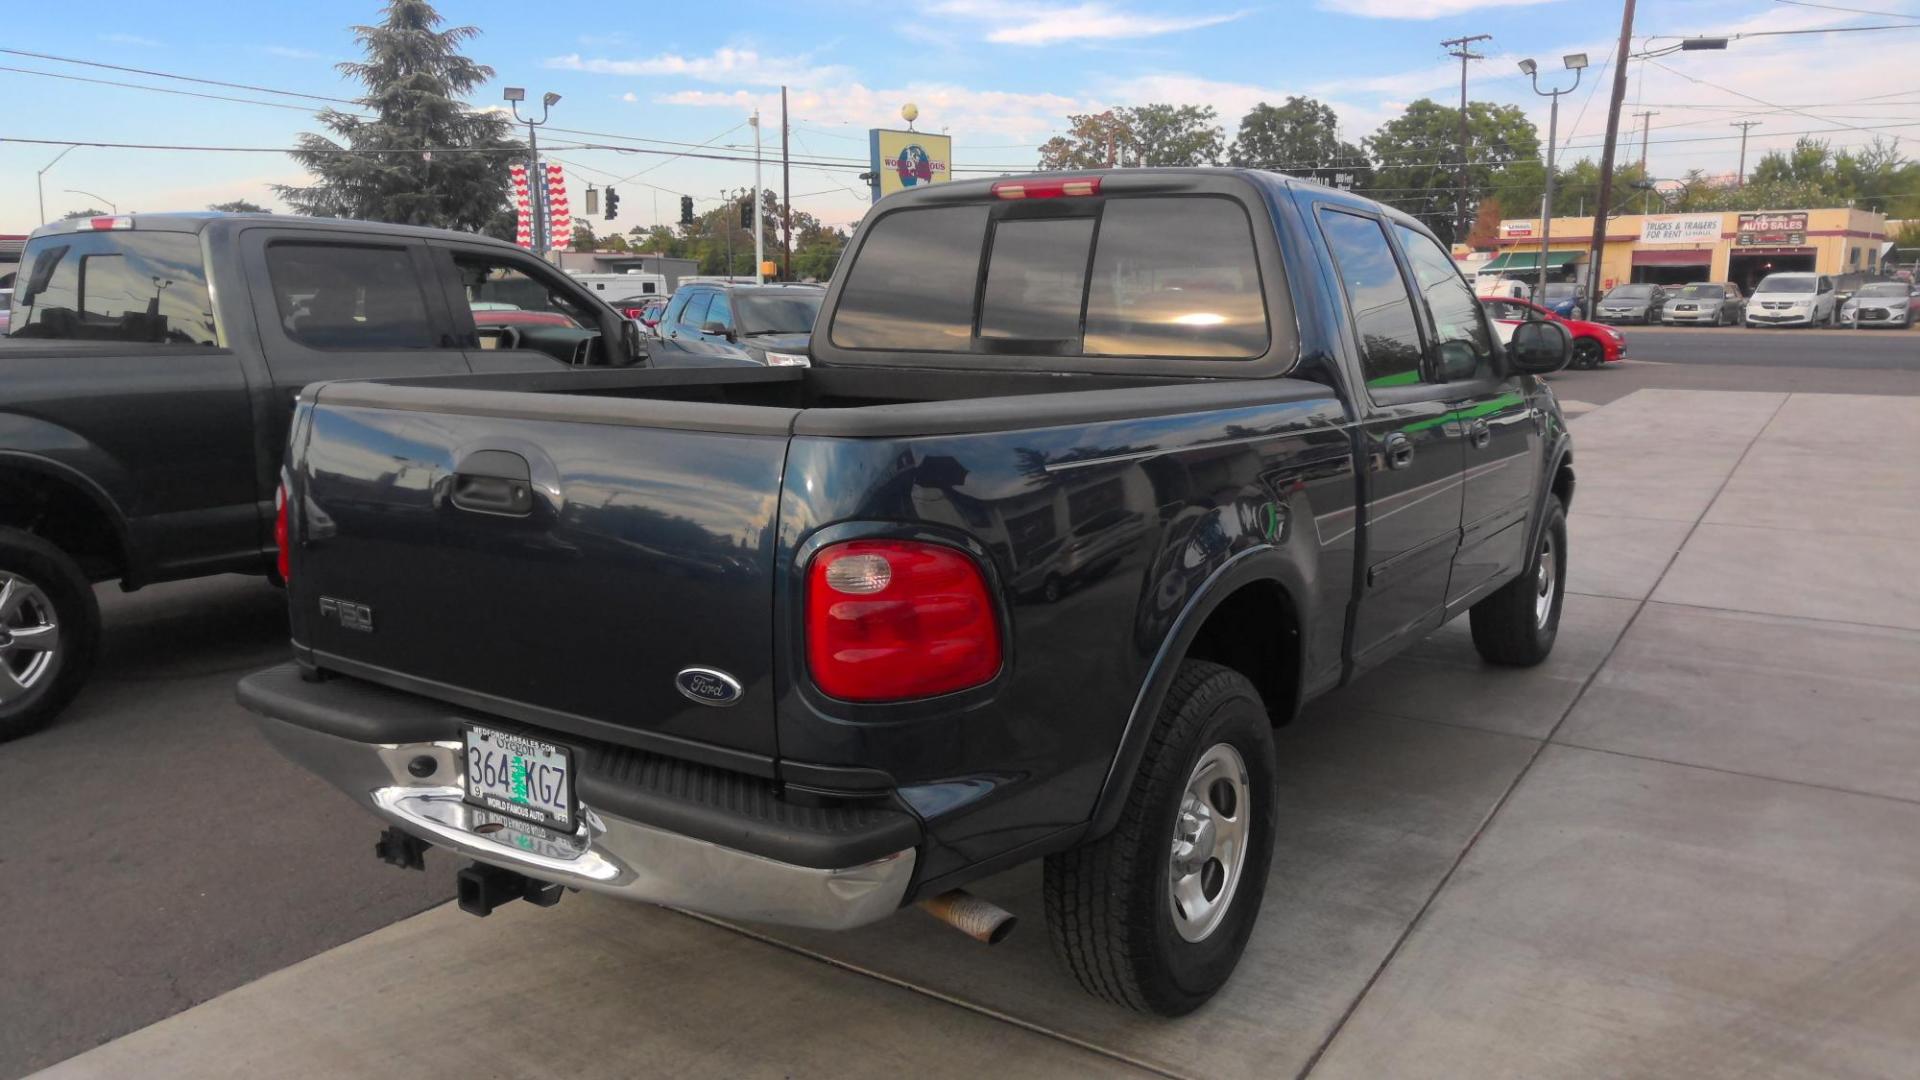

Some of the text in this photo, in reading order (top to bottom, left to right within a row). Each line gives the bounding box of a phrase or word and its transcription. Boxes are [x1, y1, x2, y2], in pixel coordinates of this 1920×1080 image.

[884, 160, 912, 168] WOD
[1647, 222, 1672, 231] TRUCKS
[1684, 221, 1717, 230] TRAILERS
[1742, 221, 1803, 231] AUTO SALES
[1646, 230, 1660, 239] FOR
[1663, 230, 1682, 238] RENT
[691, 675, 723, 696] Ford
[497, 739, 535, 757] Oregon
[470, 746, 566, 810] 364 KGZ
[487, 797, 506, 810] WORLD
[506, 803, 529, 818] FAMOUS
[529, 812, 545, 821] AUTO
